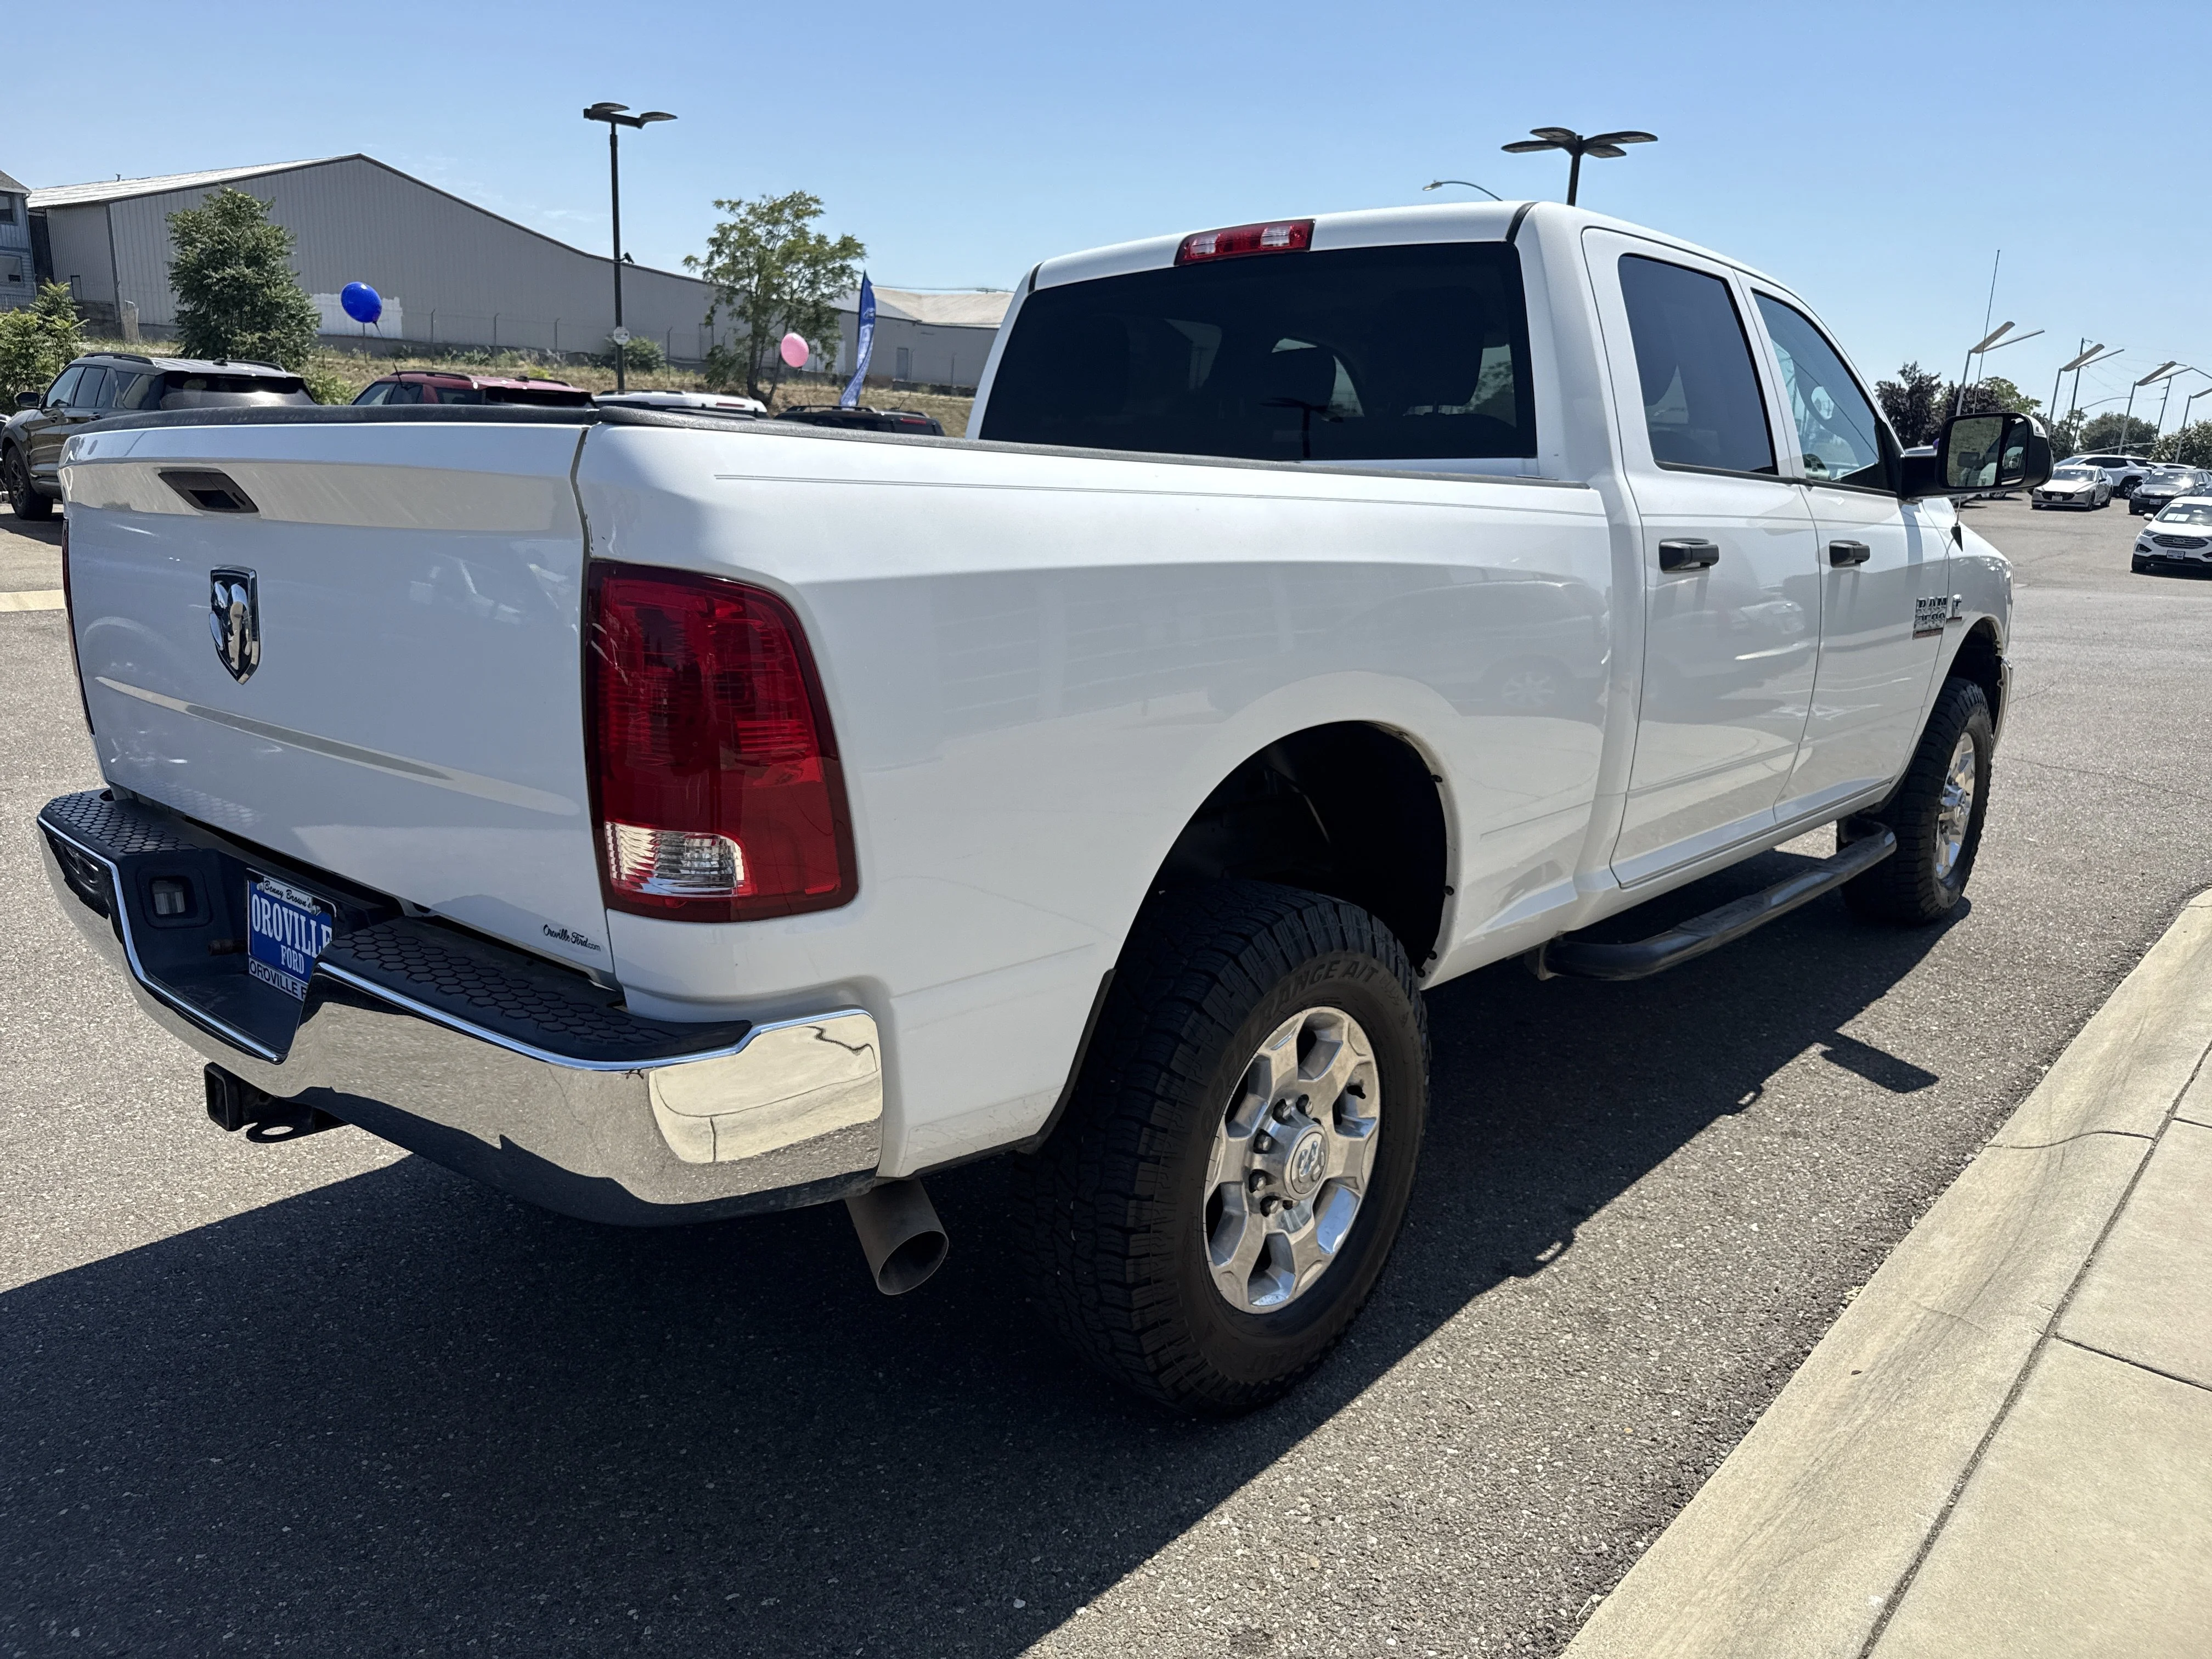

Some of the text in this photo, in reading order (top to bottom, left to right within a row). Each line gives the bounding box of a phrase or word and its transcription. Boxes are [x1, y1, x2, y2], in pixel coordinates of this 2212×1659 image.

[264, 880, 312, 909] Benny Brown's
[251, 894, 332, 959] OROVILLE
[280, 945, 304, 974] FORD
[250, 961, 298, 995] OROVILLE
[1259, 960, 1340, 1034] RANGE
[1338, 961, 1379, 983] A/T
